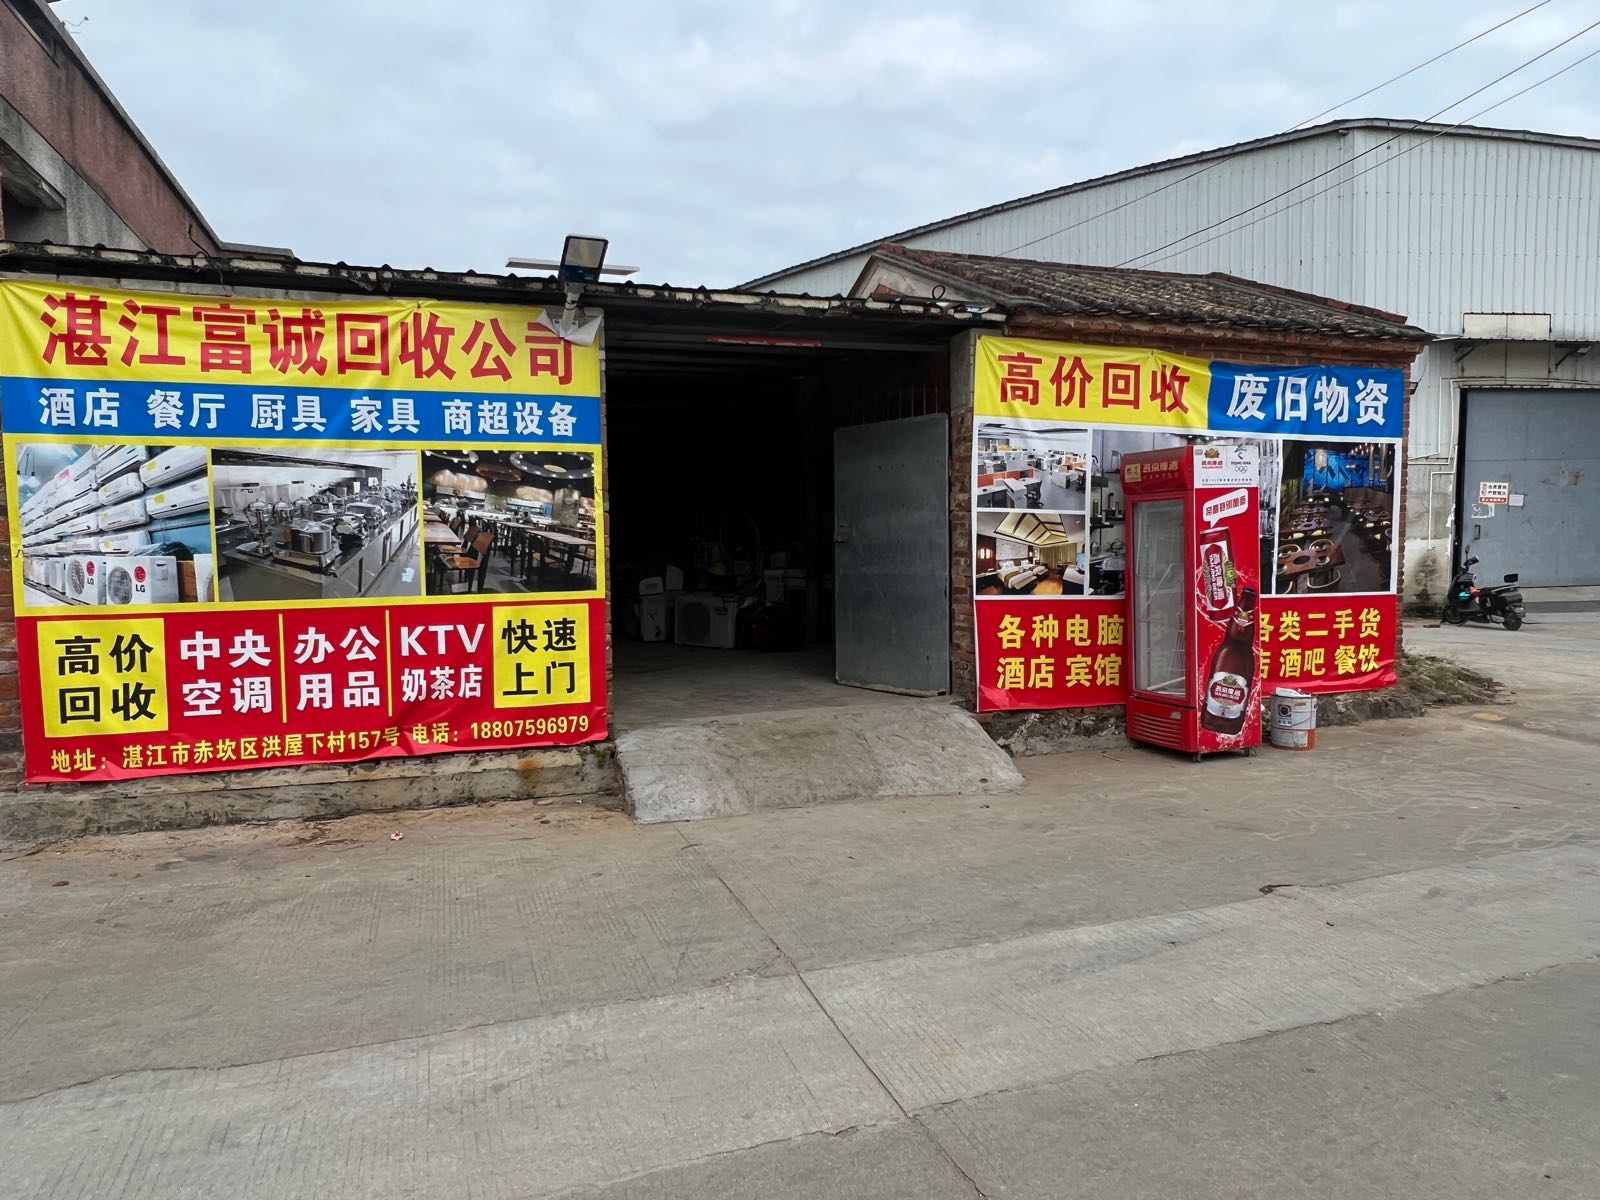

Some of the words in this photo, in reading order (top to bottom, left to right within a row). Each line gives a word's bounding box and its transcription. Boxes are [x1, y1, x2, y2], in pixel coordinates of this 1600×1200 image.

[40, 292, 573, 385] 湛江富诚回收公司
[997, 351, 1190, 416] 高价回收
[1226, 373, 1389, 427] 废旧物资
[38, 387, 120, 428] 酒店
[146, 389, 226, 430] 餐厅
[251, 393, 327, 433] 厨具
[350, 396, 421, 434] 家具
[441, 399, 577, 438] 商超设备
[86, 576, 95, 586] LG
[135, 584, 146, 594] LG
[180, 628, 272, 671] 中央
[293, 625, 380, 664] 办公
[400, 623, 485, 657] KTV
[501, 617, 577, 655] 快速
[997, 613, 1125, 650] 各种电脑
[54, 633, 154, 676] 高价
[997, 655, 1055, 690] 酒店
[1065, 653, 1123, 689] 宾馆
[1279, 647, 1326, 678] 酒吧
[1334, 643, 1380, 676] 餐饮
[182, 676, 273, 718] 空调
[296, 670, 380, 711] 用品
[401, 663, 483, 704] 奶茶店
[502, 661, 576, 697] 上门
[58, 681, 157, 725] 回收
